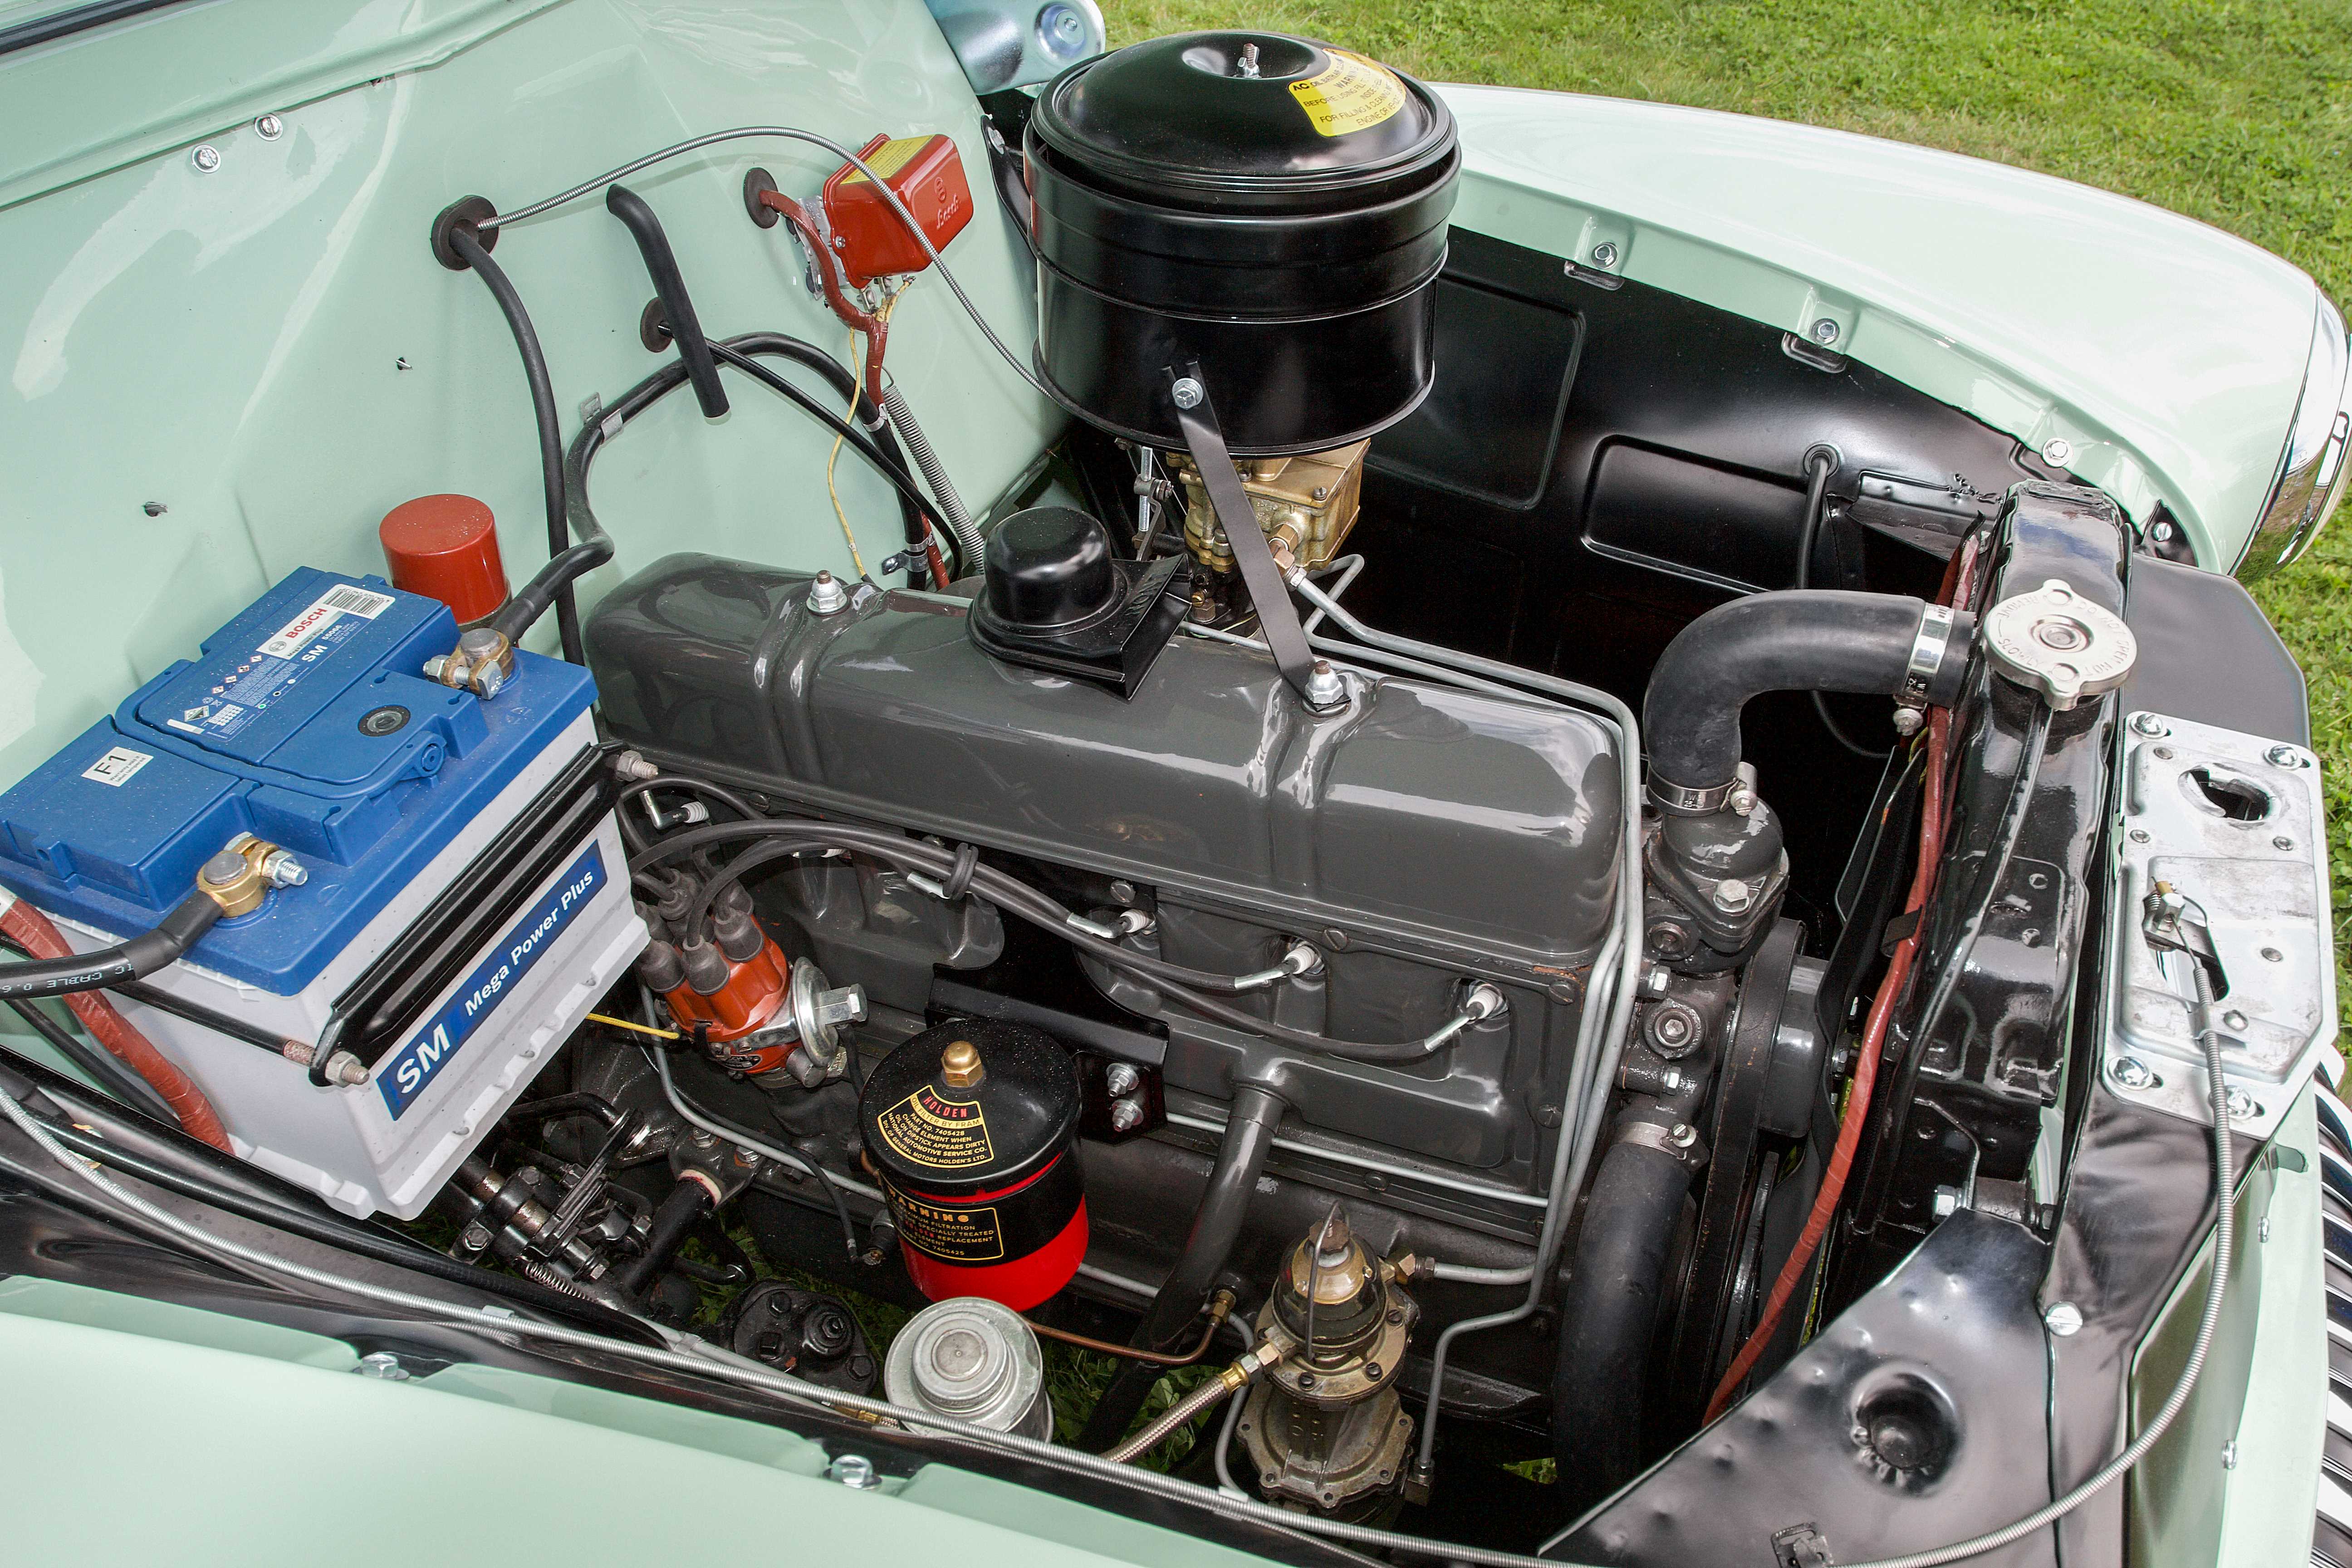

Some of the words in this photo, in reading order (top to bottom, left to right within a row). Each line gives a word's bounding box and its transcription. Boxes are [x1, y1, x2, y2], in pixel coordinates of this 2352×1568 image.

[1321, 74, 1335, 84] BATH
[1334, 66, 1359, 88] WARNING
[1303, 94, 1338, 107] BEFORE
[1338, 87, 1358, 99] USING
[1354, 82, 1366, 90] FILL
[1319, 114, 1339, 123] FOR
[1339, 106, 1366, 120] FILLING
[1370, 91, 1391, 107] CLEANING
[1356, 111, 1382, 125] ENGINE
[1382, 107, 1390, 117] OR
[1997, 595, 2040, 618] REMOVE
[2076, 602, 2097, 614] DO
[284, 608, 328, 638] BOSCH
[2098, 617, 2127, 635] NOT
[287, 645, 300, 657] Mega
[299, 636, 314, 648] Power
[313, 628, 323, 638] Plus
[301, 644, 328, 662] SM
[1999, 638, 2044, 666] SLOWLY
[2112, 639, 2130, 664] OPEN
[93, 755, 127, 775] F1
[109, 764, 129, 781] Warranty
[47, 971, 103, 989] CABLE
[396, 1023, 451, 1094] SM
[464, 963, 510, 1017] Mega
[510, 907, 559, 965] Power
[560, 870, 594, 911] Plus
[918, 1108, 939, 1124] FILTER
[956, 1119, 980, 1128] FRAM
[923, 1096, 968, 1118] HOLDEN
[902, 1113, 921, 1133] CHANGE
[920, 1130, 950, 1143] ELEMENT
[910, 1112, 923, 1125] PART
[888, 1112, 905, 1138] NATIONAL
[902, 1137, 942, 1156] AUTOMOTIVE
[900, 1123, 909, 1132] ON
[907, 1130, 933, 1147] DIPSTICK
[965, 1139, 985, 1149] DIRTY
[892, 1137, 912, 1154] GENERAL
[912, 1152, 937, 1163] MOTORS
[887, 1185, 969, 1223] WARNING
[918, 1223, 956, 1237] SPECIALLY
[931, 1221, 976, 1230] FILTRATION
[914, 1231, 946, 1247] ELEMENT
[937, 1235, 993, 1244] REPLACEMENT
